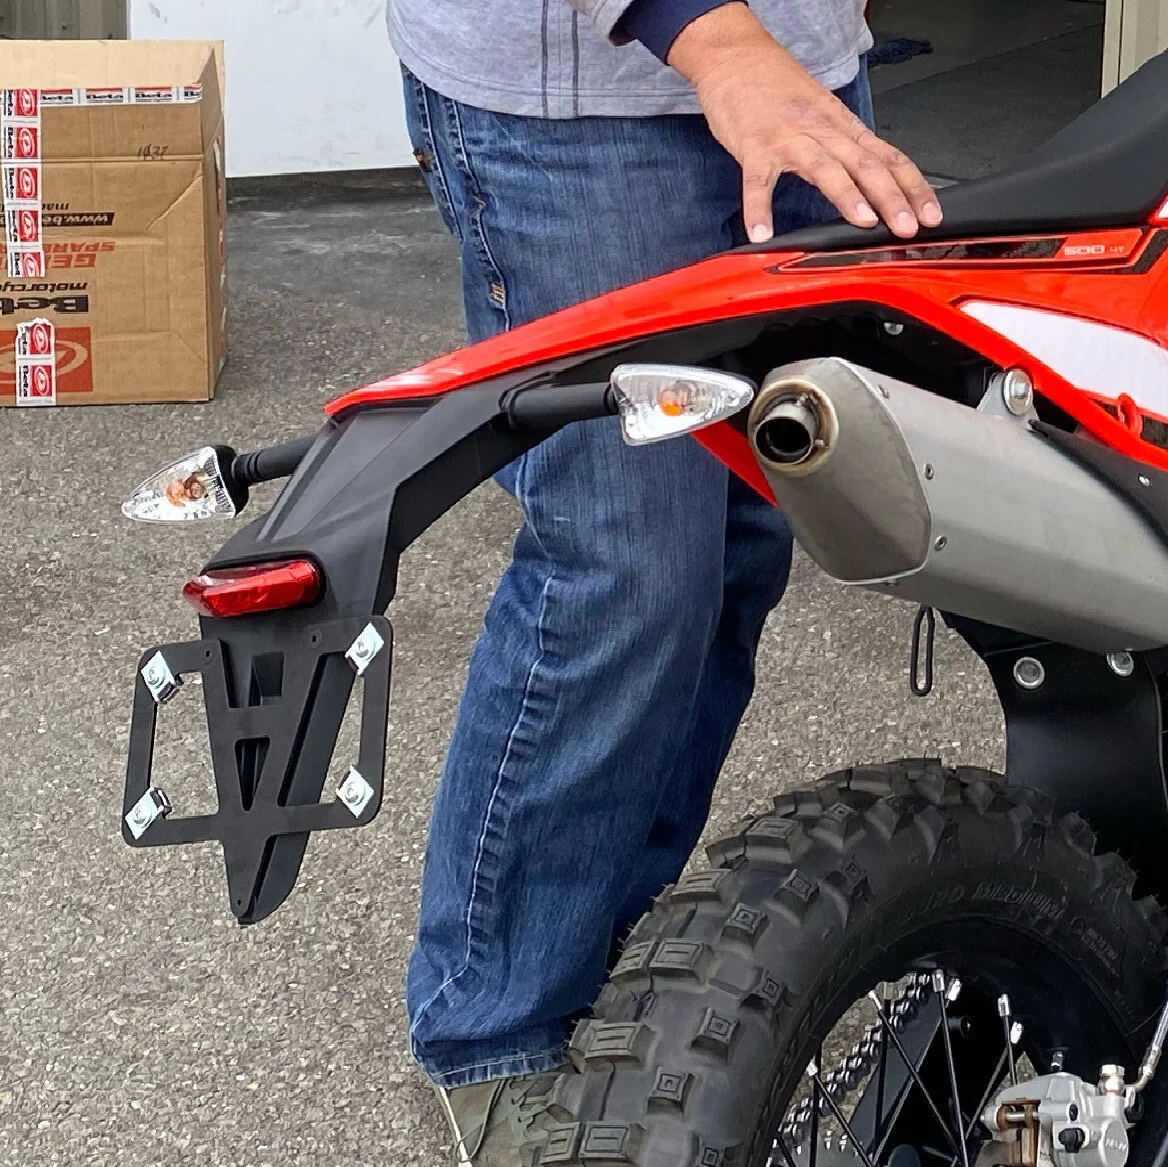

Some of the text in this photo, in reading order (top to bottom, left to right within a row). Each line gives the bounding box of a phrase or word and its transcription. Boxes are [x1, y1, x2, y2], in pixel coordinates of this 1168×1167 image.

[1064, 245, 1105, 256] 500
[0, 282, 88, 292] motorcy
[0, 295, 88, 314] Bet
